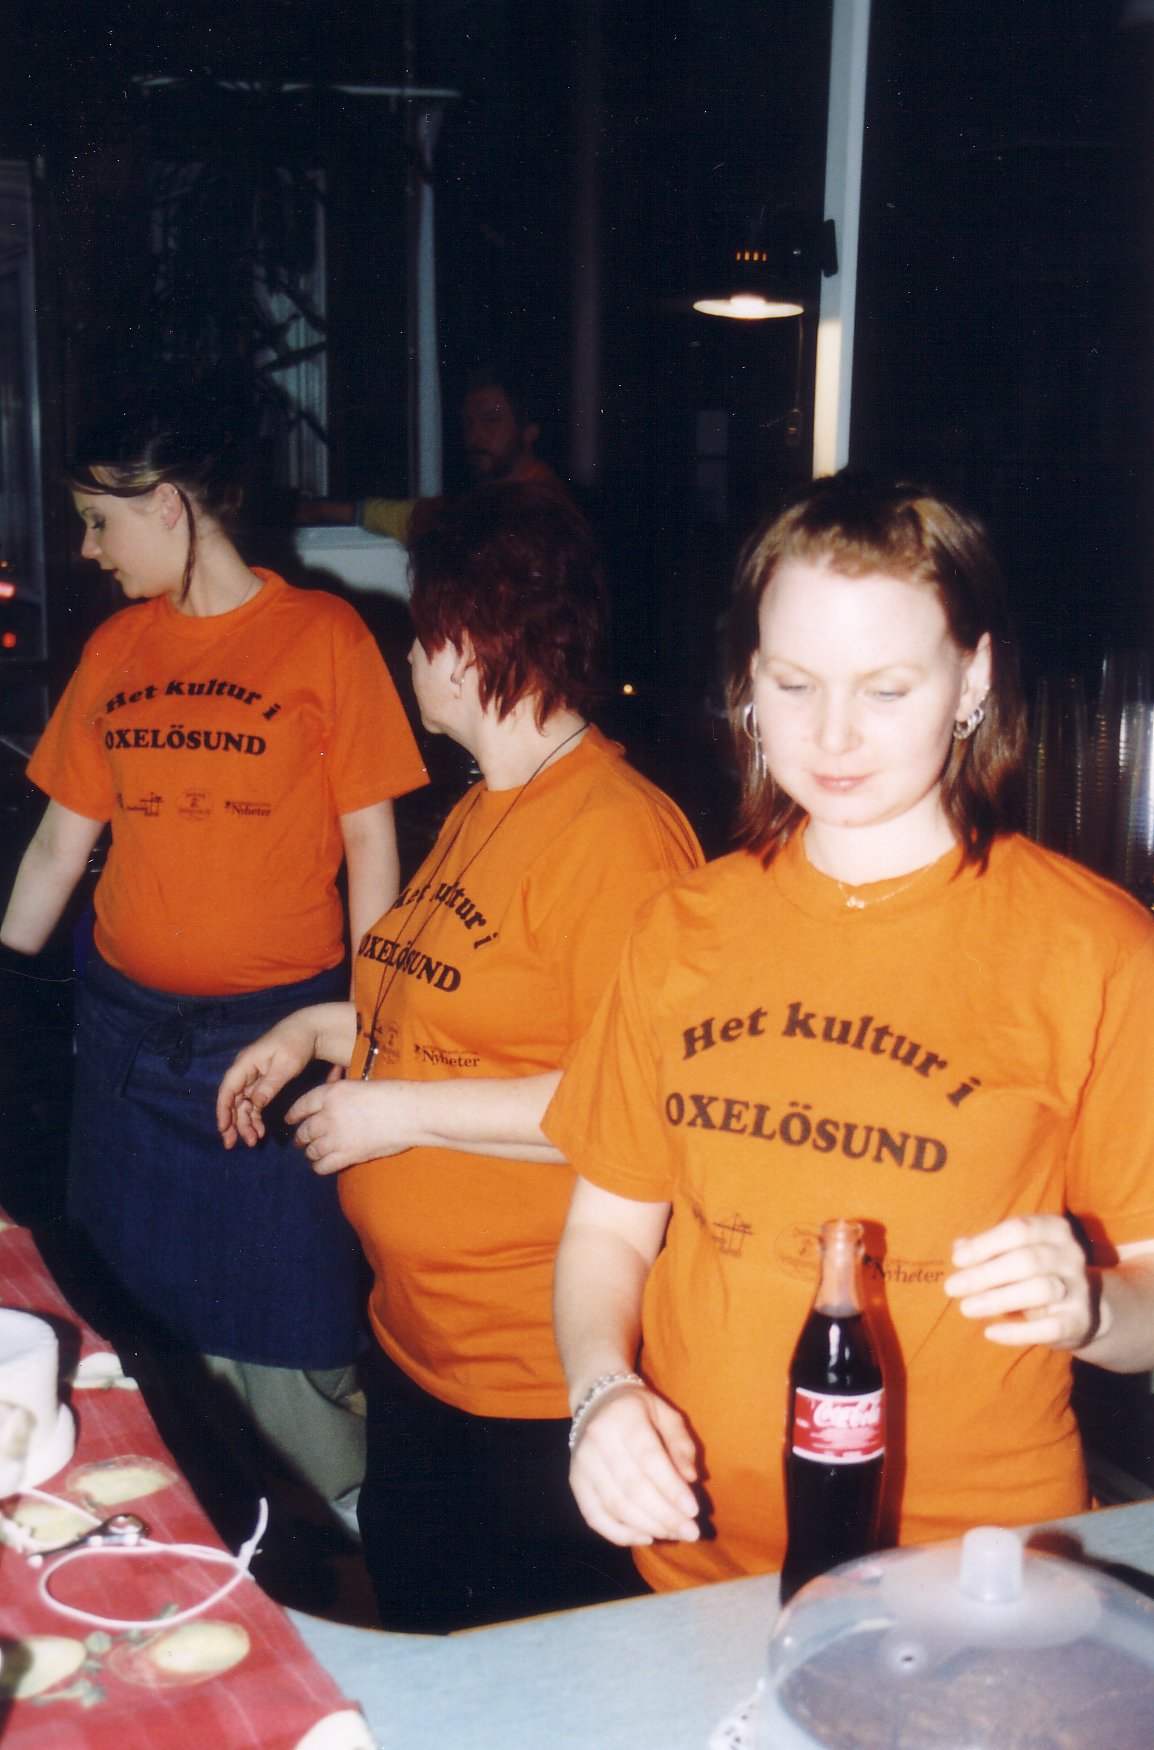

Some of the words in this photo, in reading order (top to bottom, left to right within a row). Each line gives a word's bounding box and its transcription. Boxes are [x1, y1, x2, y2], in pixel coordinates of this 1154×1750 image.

[105, 685, 158, 714] Het
[262, 703, 281, 721] i
[105, 724, 266, 756] OXELÖSUND
[473, 932, 498, 950] i
[422, 1049, 480, 1068] Nyheter
[682, 1007, 768, 1060] Het
[782, 1001, 948, 1078] kultur
[946, 1076, 982, 1108] i
[665, 1092, 948, 1173] OXELÖSUND
